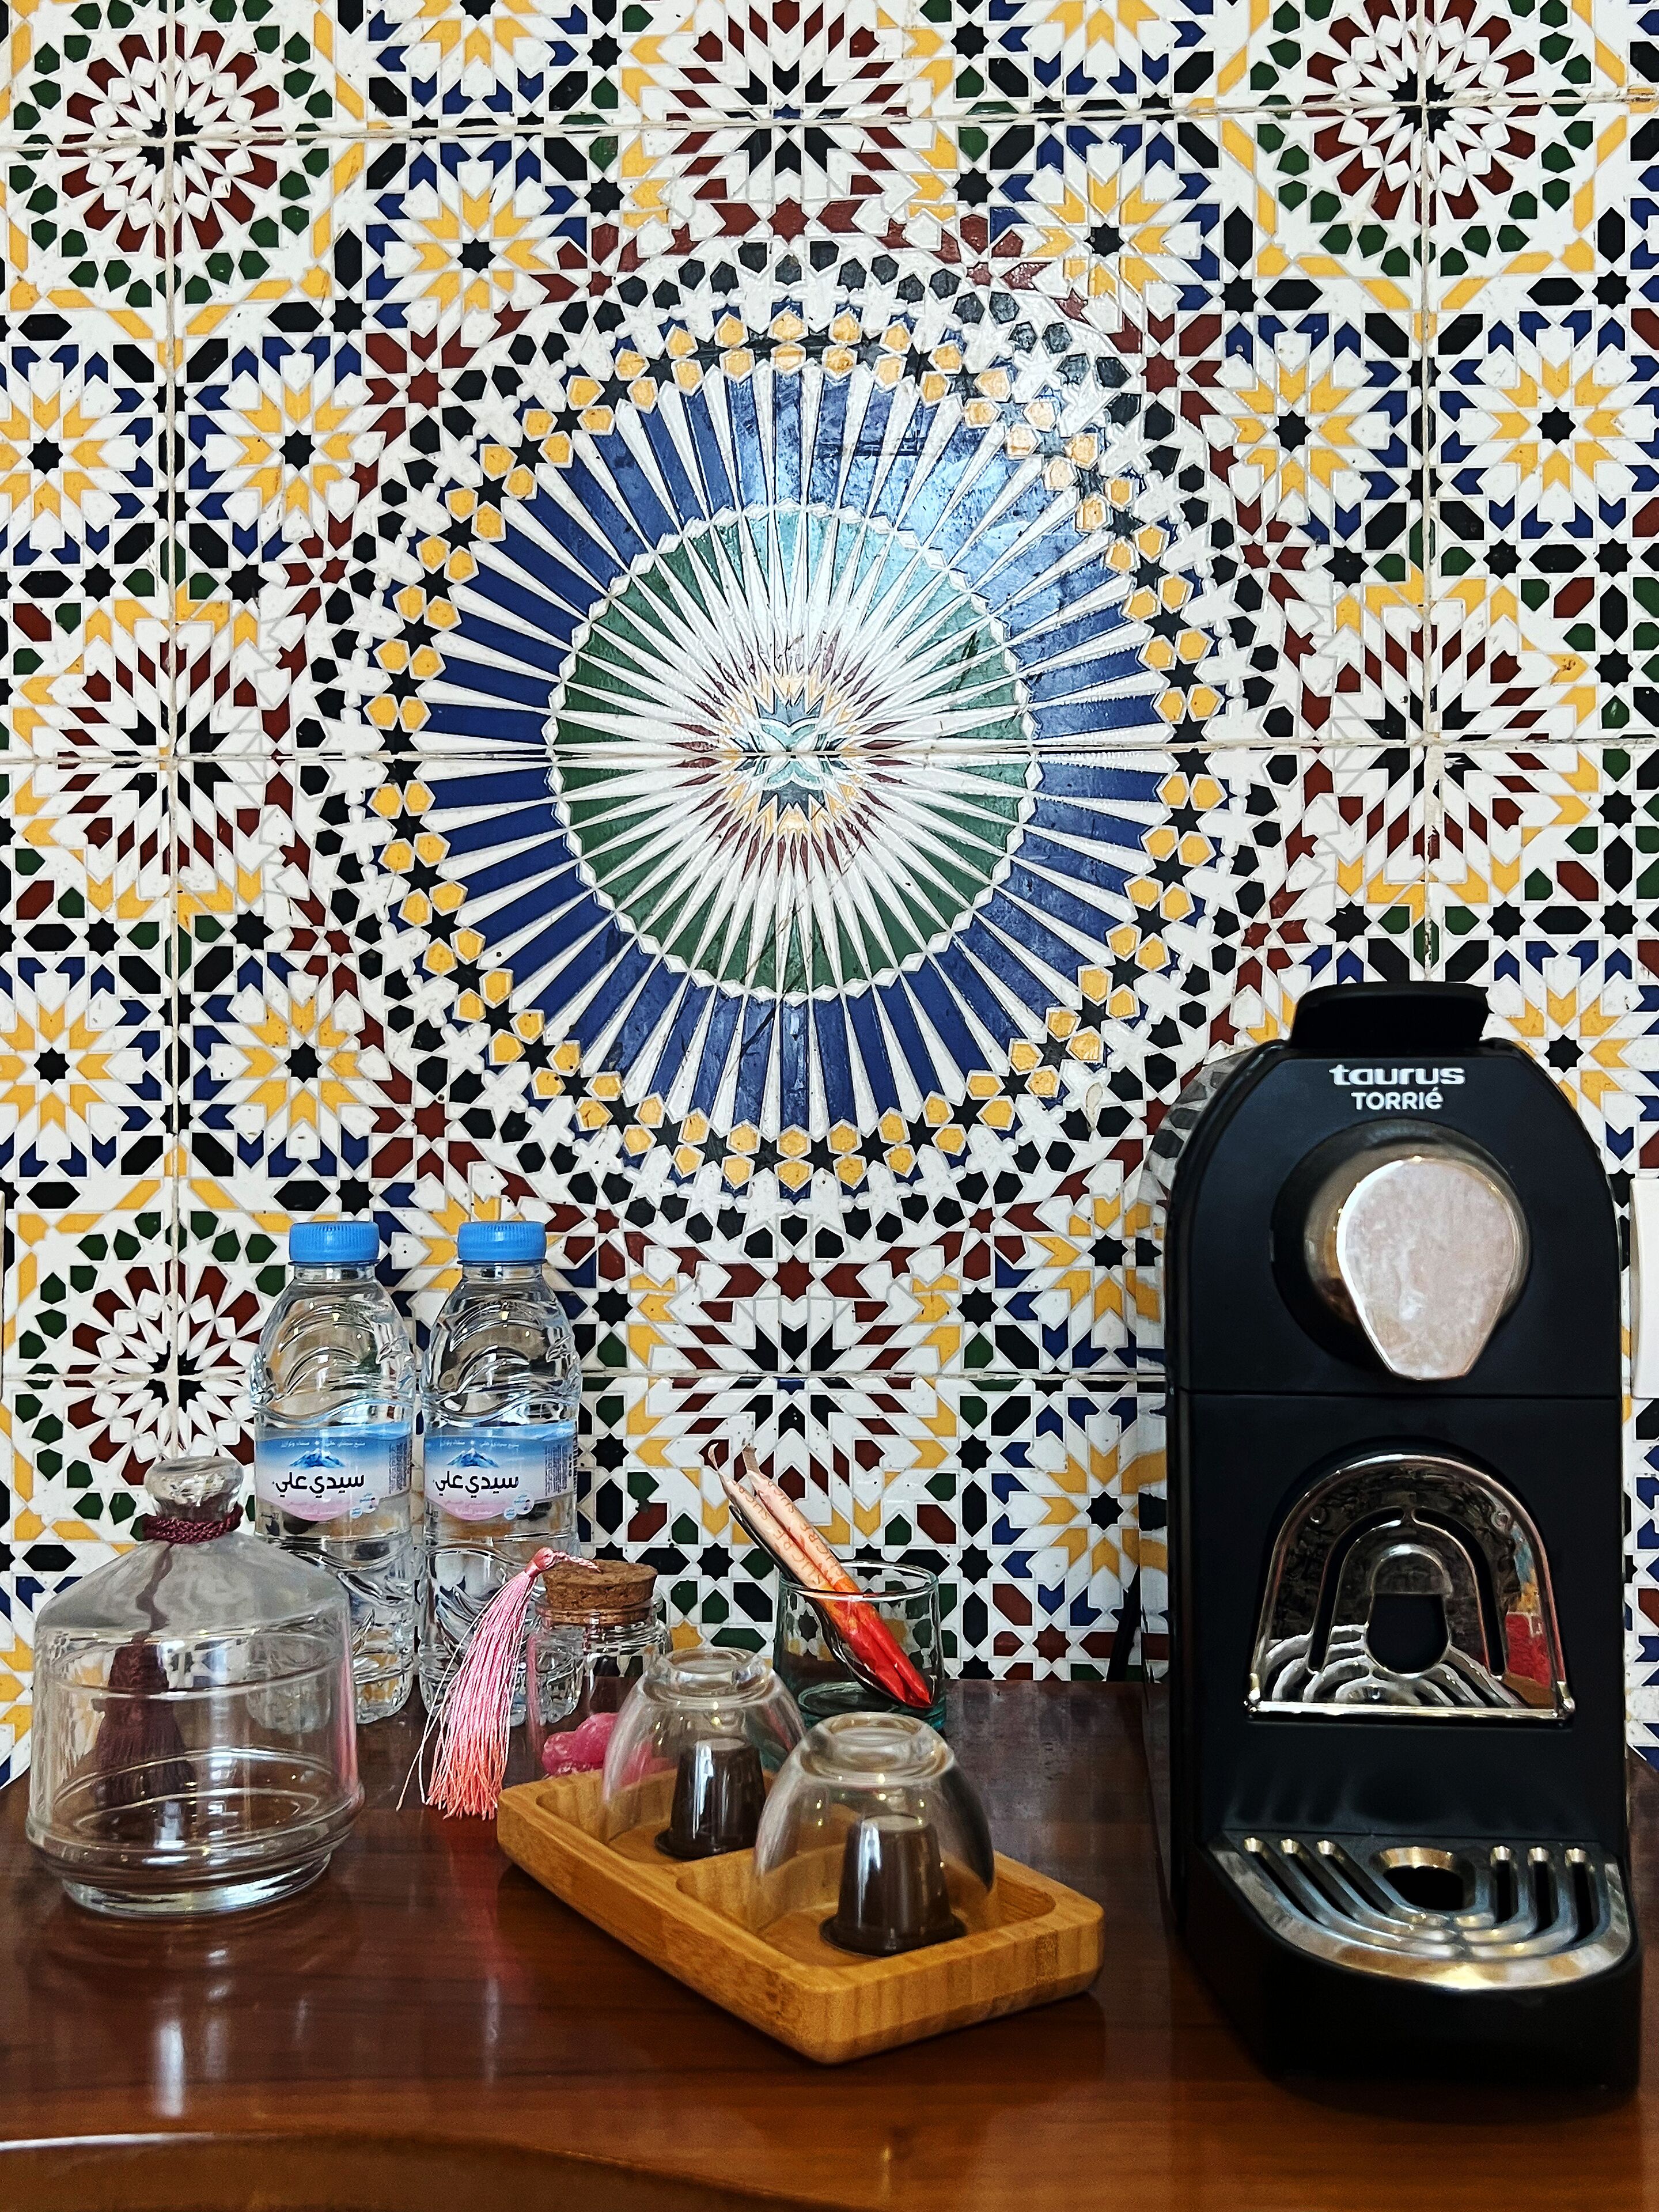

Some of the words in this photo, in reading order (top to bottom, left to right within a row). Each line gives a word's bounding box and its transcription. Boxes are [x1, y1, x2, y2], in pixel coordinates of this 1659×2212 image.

[1329, 1064, 1466, 1086] taurus
[1350, 1086, 1444, 1111] TORRIé
[275, 1471, 308, 1498] علي
[309, 1475, 365, 1499] سيدي
[434, 1470, 464, 1497] علي
[464, 1475, 519, 1498] سيدي
[774, 1529, 822, 1585] SUCRE
